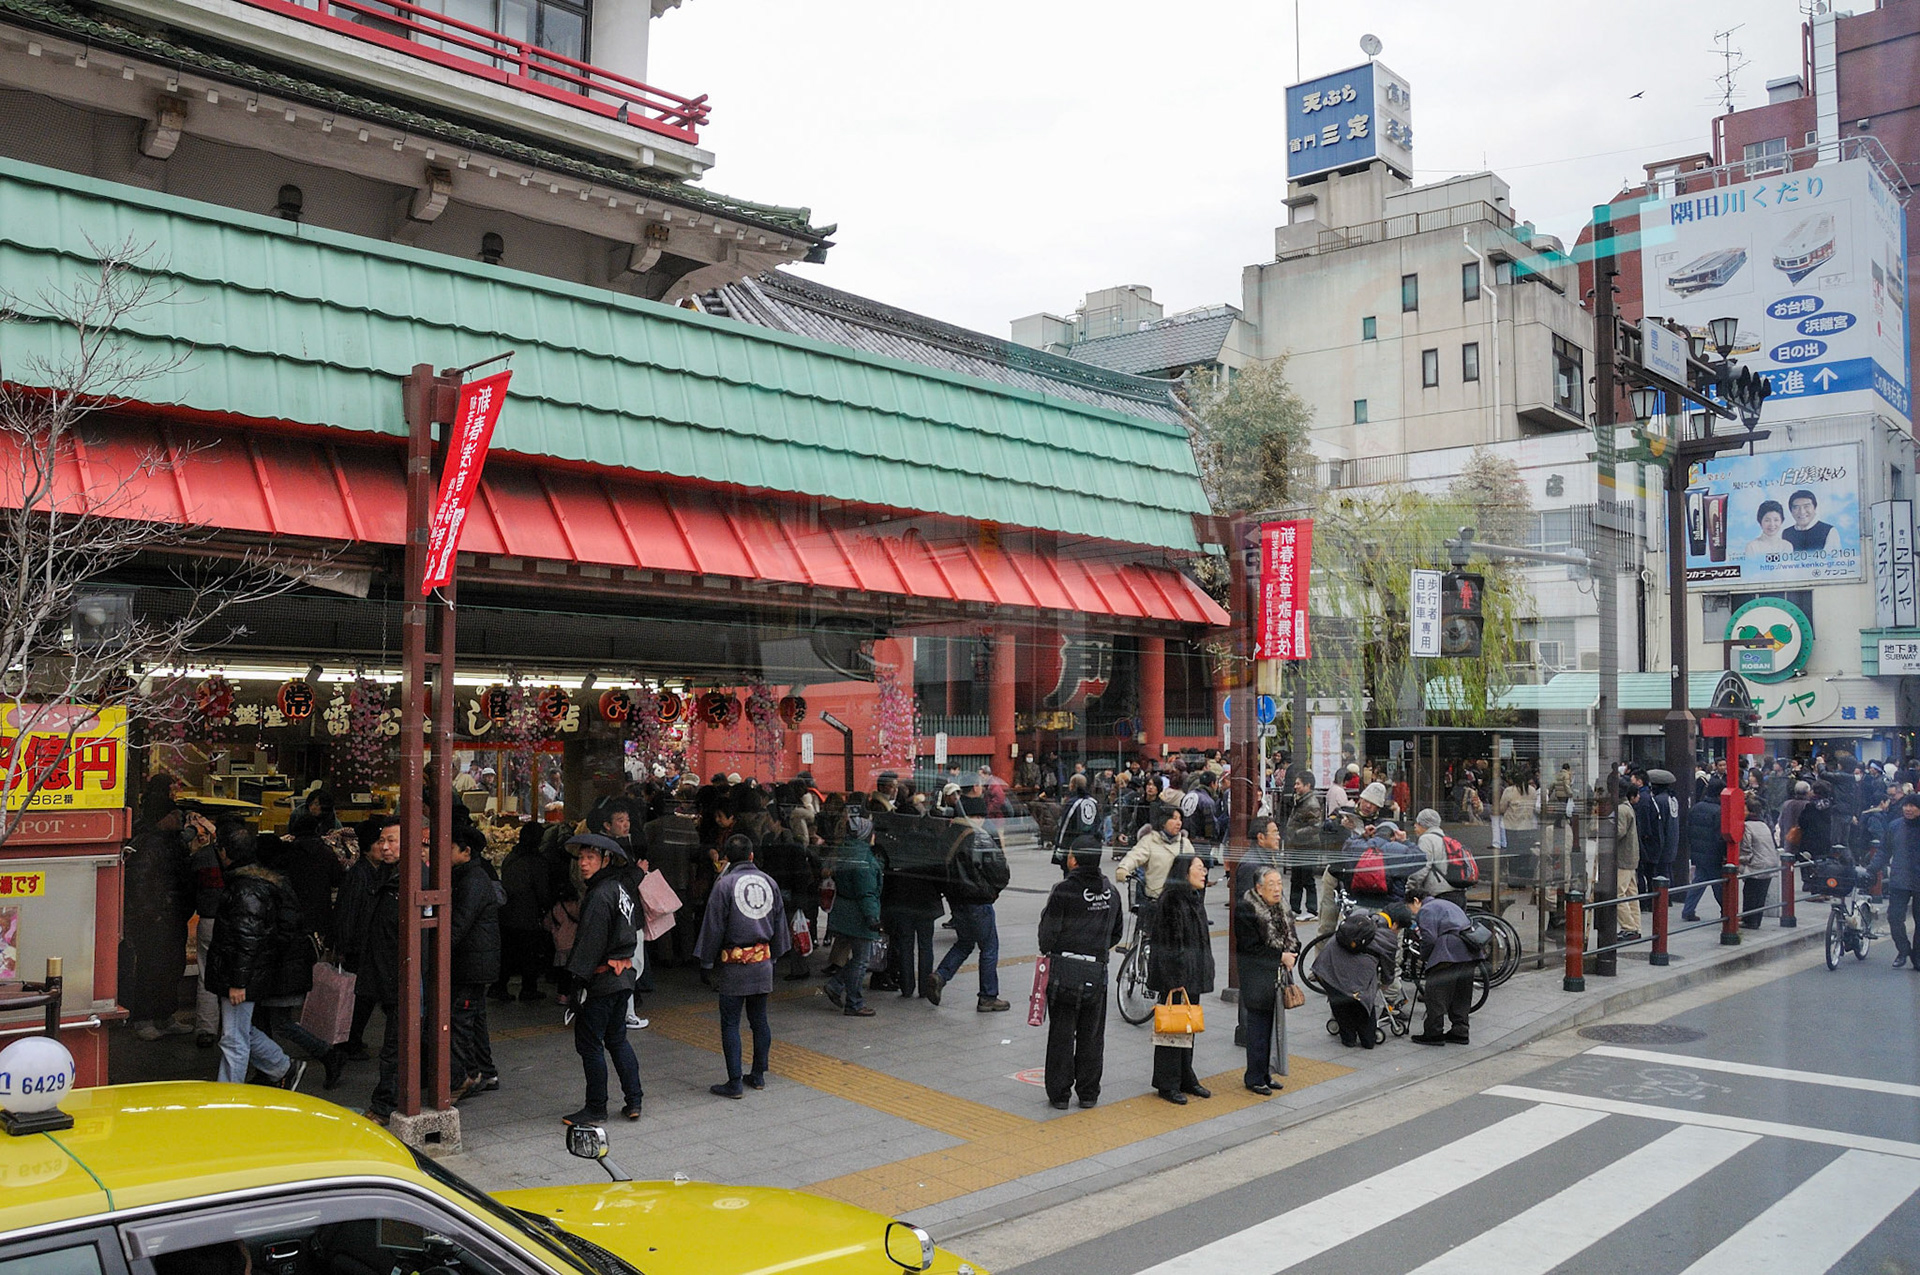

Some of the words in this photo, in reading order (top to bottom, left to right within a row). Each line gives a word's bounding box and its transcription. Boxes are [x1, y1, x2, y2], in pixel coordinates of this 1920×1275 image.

[1302, 84, 1357, 114] 天ぷら
[1670, 177, 1823, 225] 隅田川くだり
[1774, 298, 1816, 316] お台場
[1805, 315, 1848, 333] 浜離宮
[1778, 343, 1819, 360] 日の出
[1782, 549, 1856, 562] 0120-40-2161
[1416, 578, 1426, 619] 自転車
[1427, 578, 1438, 620] 歩行者
[1420, 622, 1432, 649] 専用
[1884, 644, 1918, 654] 地下鉄
[1841, 706, 1880, 720] 浅草
[22, 1073, 65, 1095] 6429
